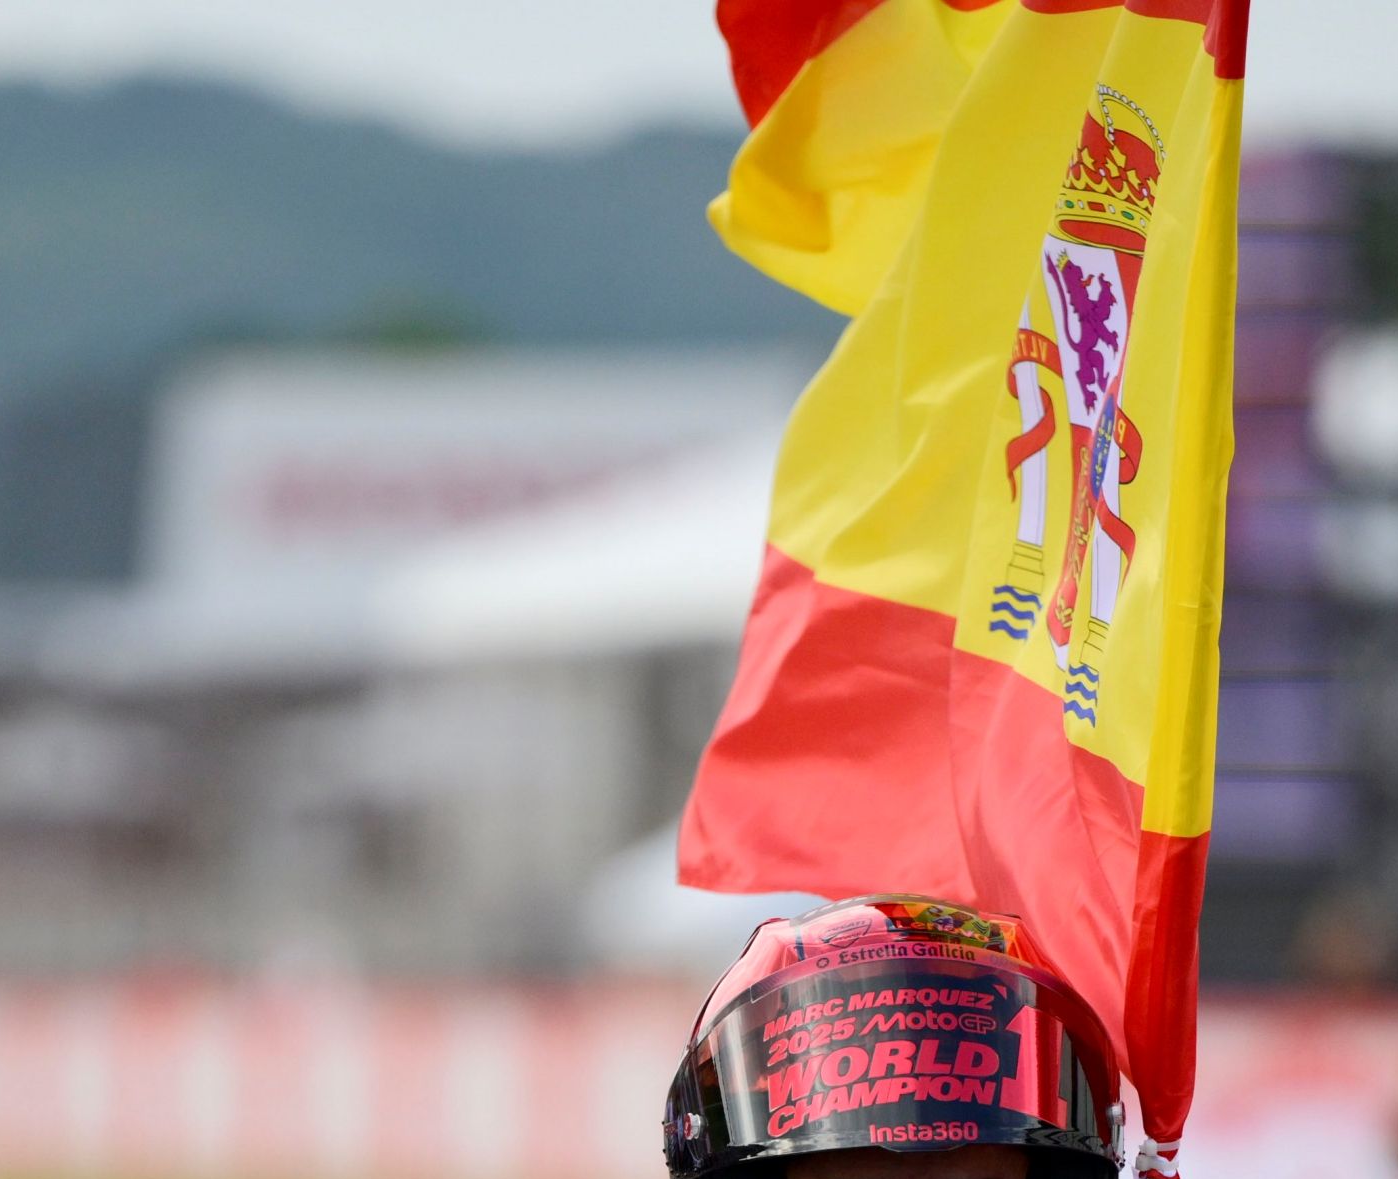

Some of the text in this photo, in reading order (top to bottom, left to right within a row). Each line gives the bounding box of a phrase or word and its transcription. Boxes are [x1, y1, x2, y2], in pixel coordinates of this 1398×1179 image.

[838, 944, 907, 964] Estrella
[912, 943, 976, 961] Galicia
[763, 987, 995, 1042] MARC MARQUEZ
[767, 1016, 857, 1067] 2025
[768, 1039, 1000, 1112] WORLD
[999, 1005, 1068, 1131] 1
[767, 1076, 996, 1138] CHAMPION
[869, 1121, 979, 1143] Insta360
